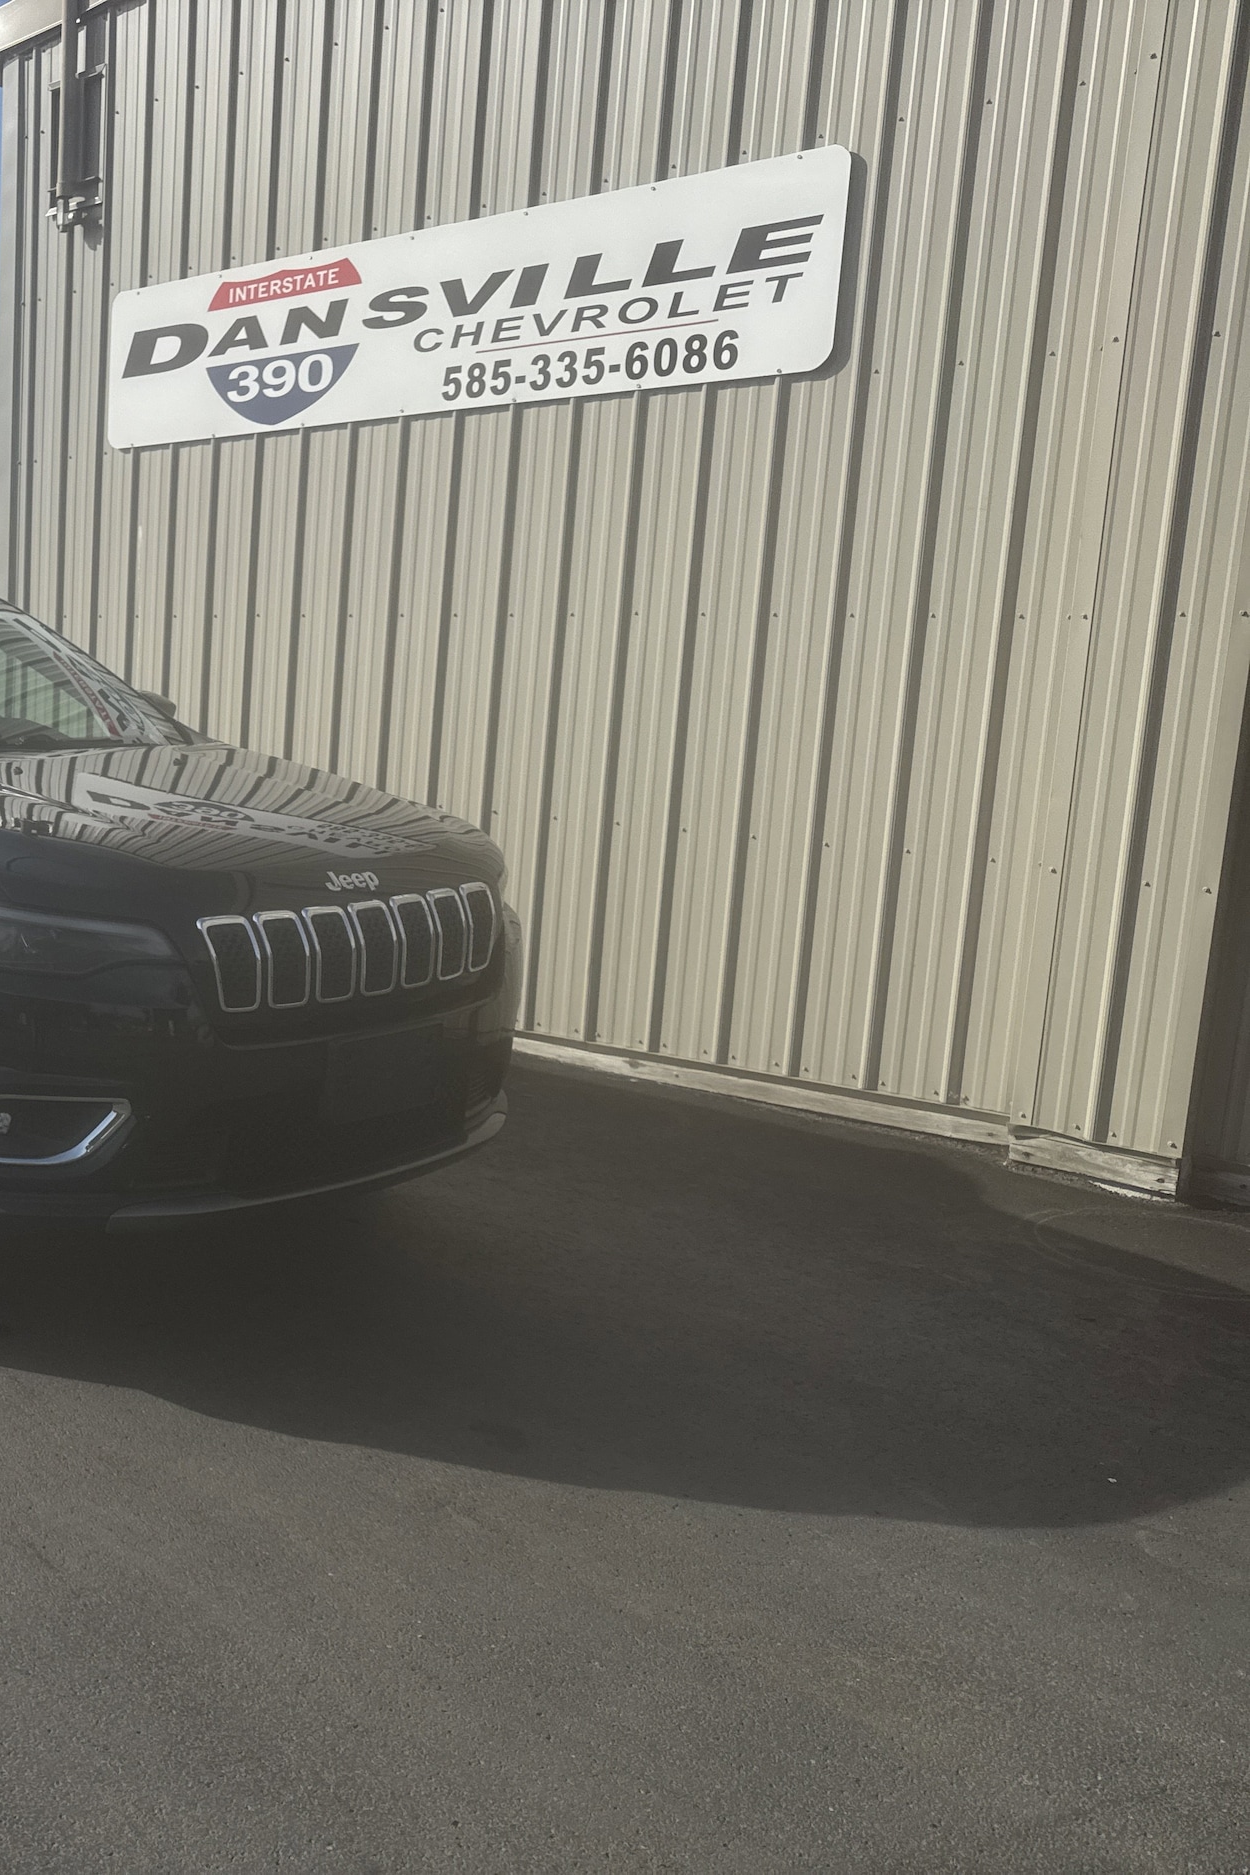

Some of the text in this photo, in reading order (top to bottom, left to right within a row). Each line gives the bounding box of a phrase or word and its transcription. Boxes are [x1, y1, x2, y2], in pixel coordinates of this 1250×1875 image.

[228, 268, 340, 304] INTERSTATE
[413, 272, 805, 353] CHEVROLET
[226, 353, 334, 403] 390
[441, 329, 740, 403] 585-335-6086
[324, 871, 380, 891] Jeep
